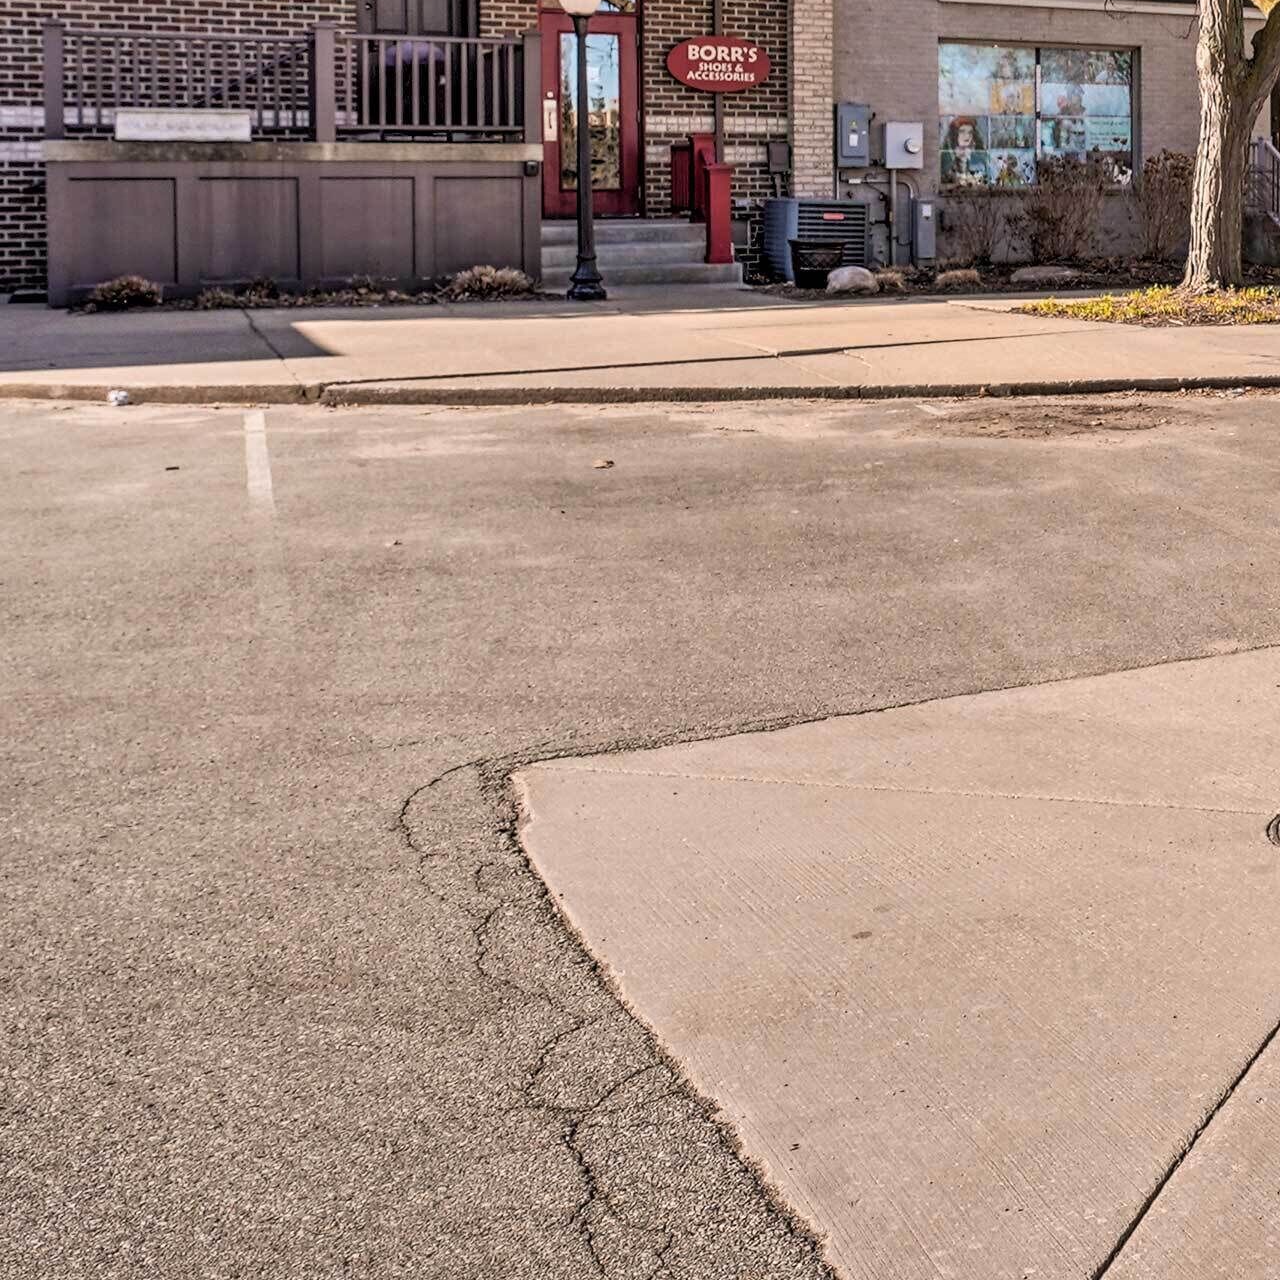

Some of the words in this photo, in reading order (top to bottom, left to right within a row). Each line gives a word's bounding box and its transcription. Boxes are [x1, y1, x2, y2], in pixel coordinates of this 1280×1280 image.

[687, 44, 758, 63] BORR'S
[698, 62, 732, 72] SHOES
[735, 63, 744, 73] &
[686, 70, 755, 82] ACCESSORIES
